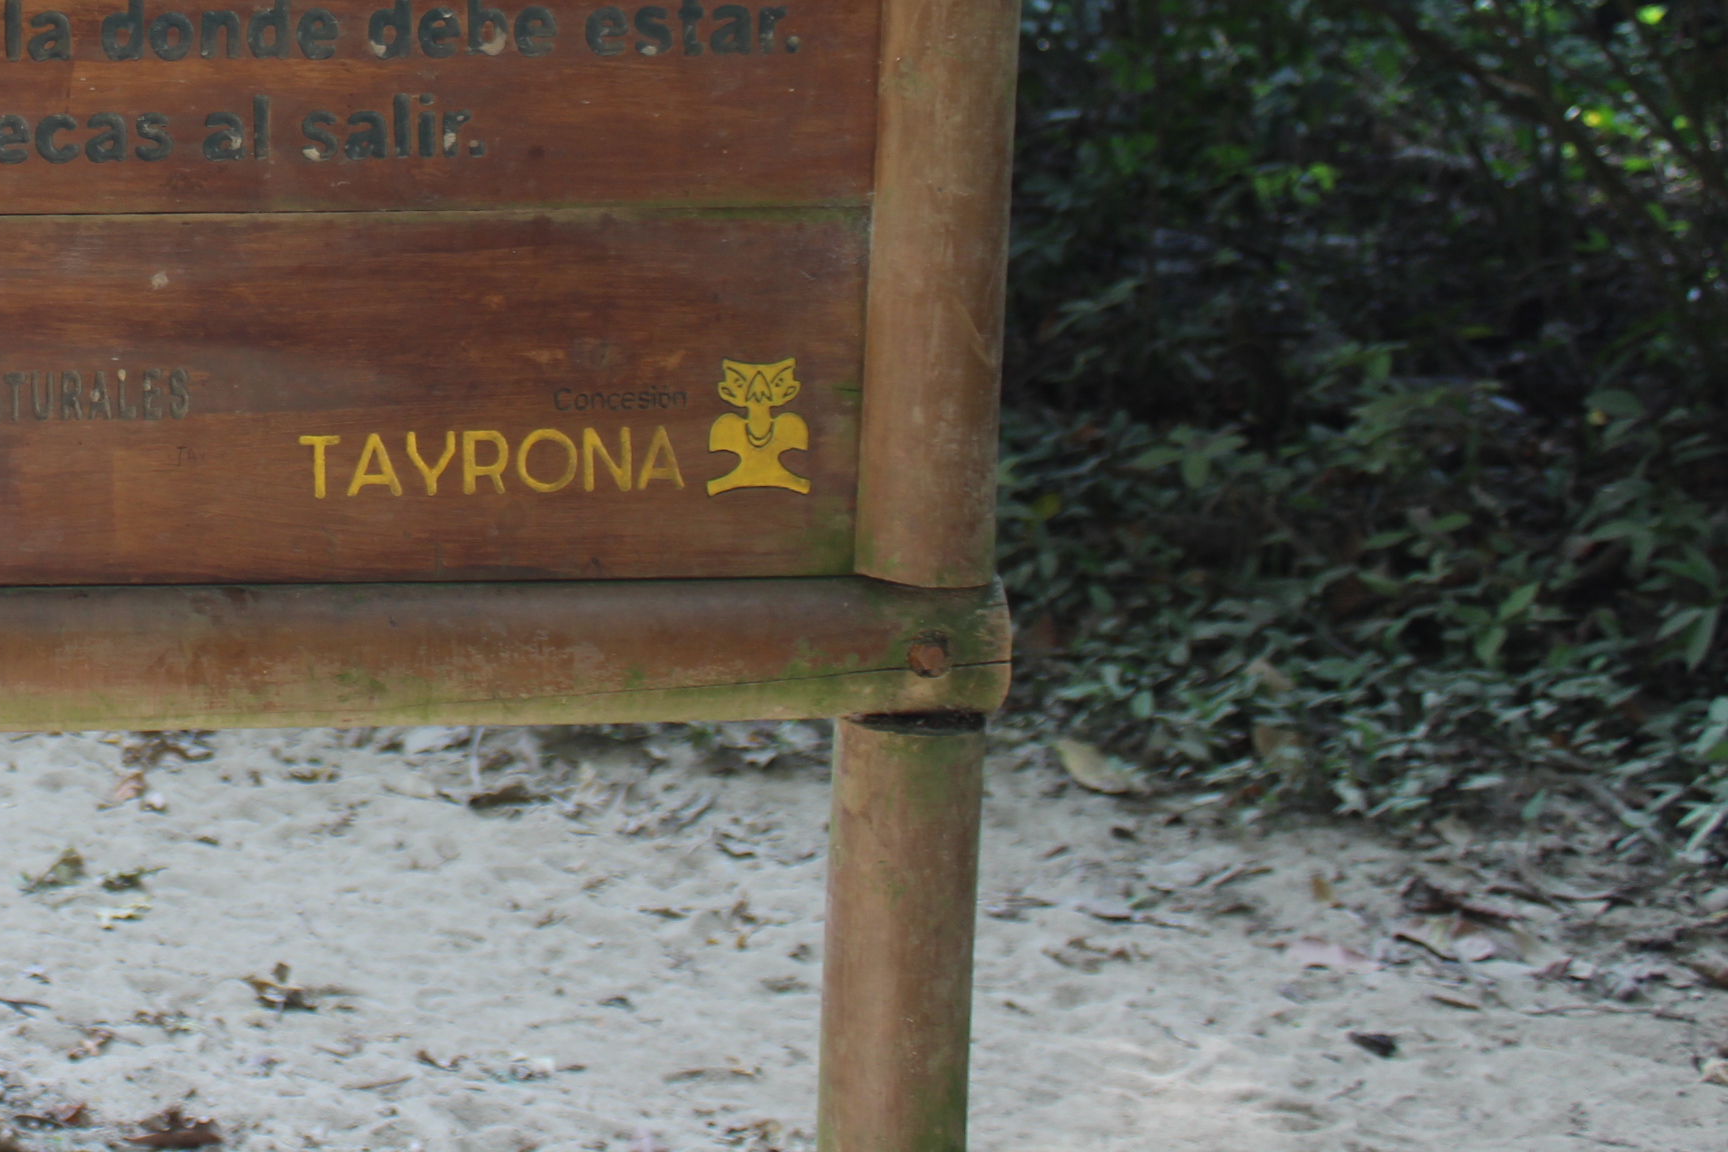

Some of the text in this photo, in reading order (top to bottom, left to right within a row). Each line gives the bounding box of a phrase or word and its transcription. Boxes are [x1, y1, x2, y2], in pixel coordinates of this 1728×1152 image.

[202, 94, 270, 162] al
[301, 92, 488, 162] salir.
[298, 425, 686, 498] TAYRONA
